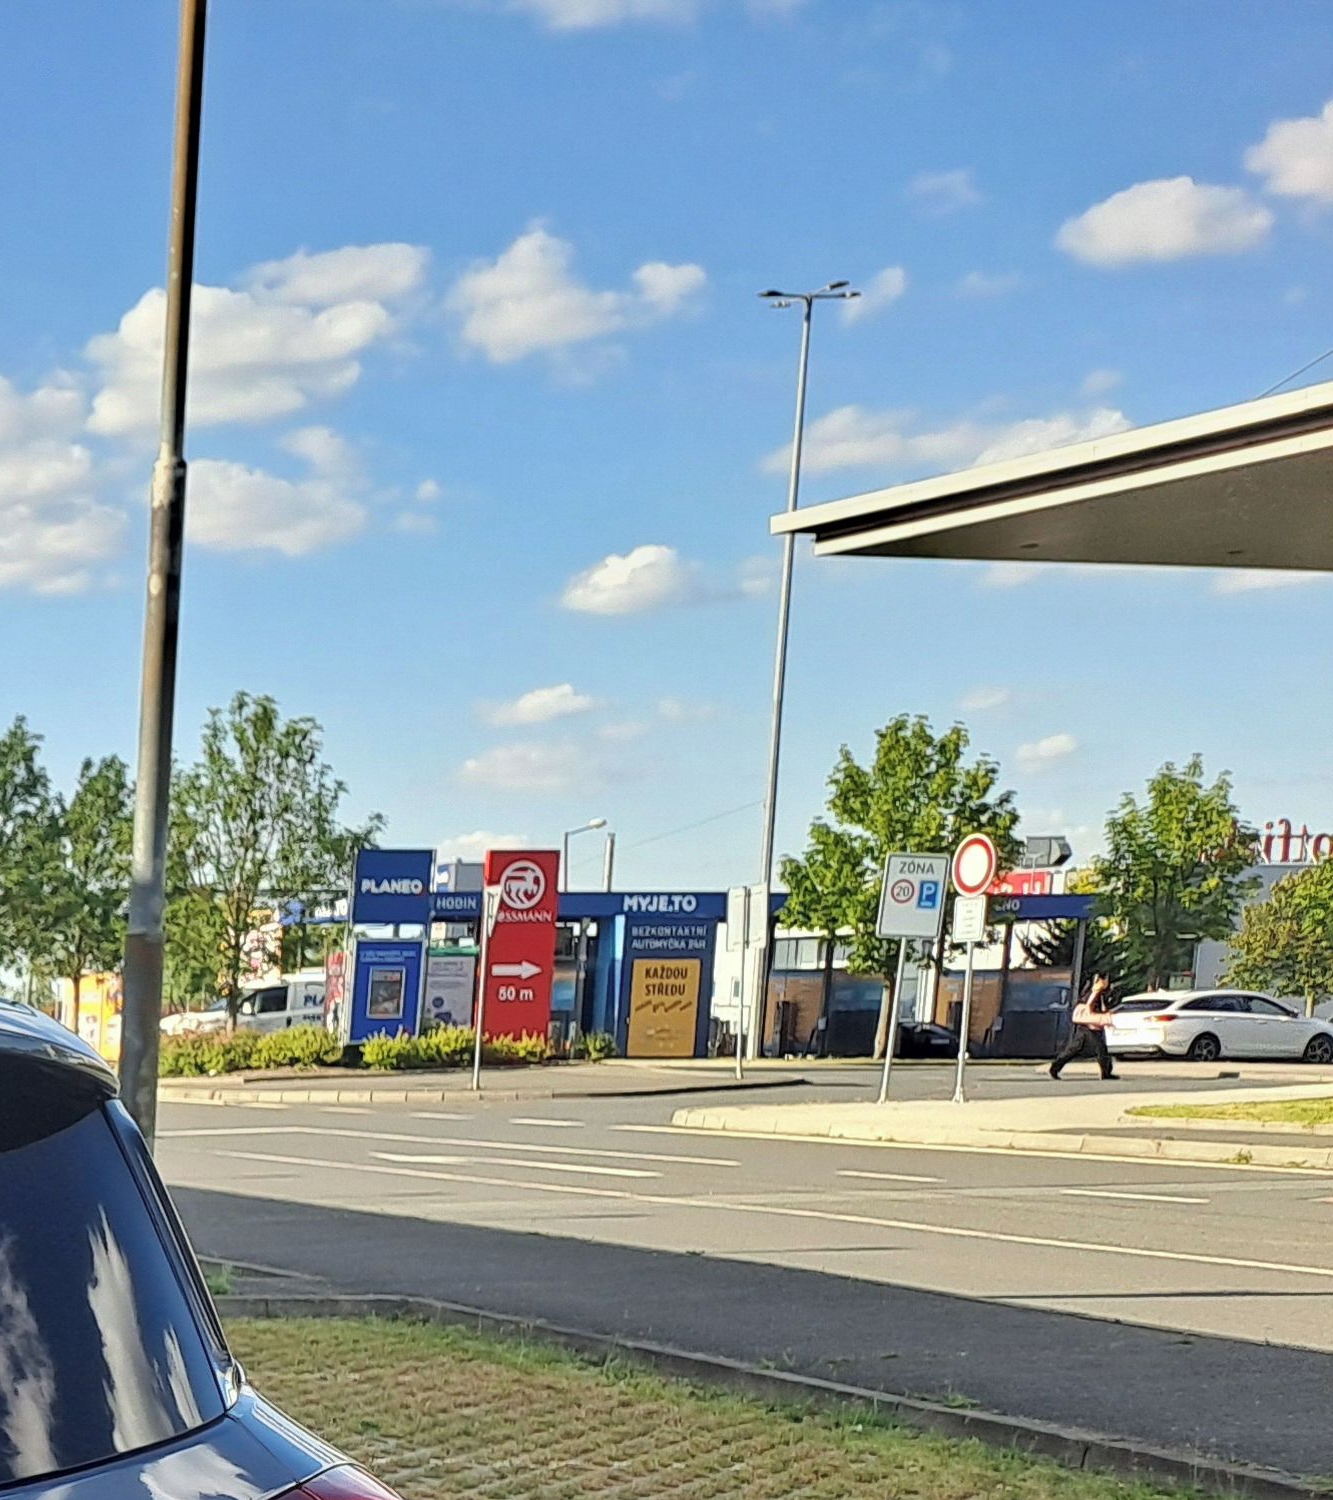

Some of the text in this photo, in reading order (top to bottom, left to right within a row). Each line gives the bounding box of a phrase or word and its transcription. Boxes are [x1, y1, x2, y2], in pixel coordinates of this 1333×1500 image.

[899, 860, 935, 874] ZÓNA
[360, 878, 423, 894] PLANEO
[896, 886, 910, 897] 20
[623, 894, 697, 912] MYJE.TO
[497, 910, 553, 923] OSSMANN
[645, 964, 688, 979] KAŽDOU
[519, 987, 533, 1001] m
[645, 983, 686, 996] STŘEDU
